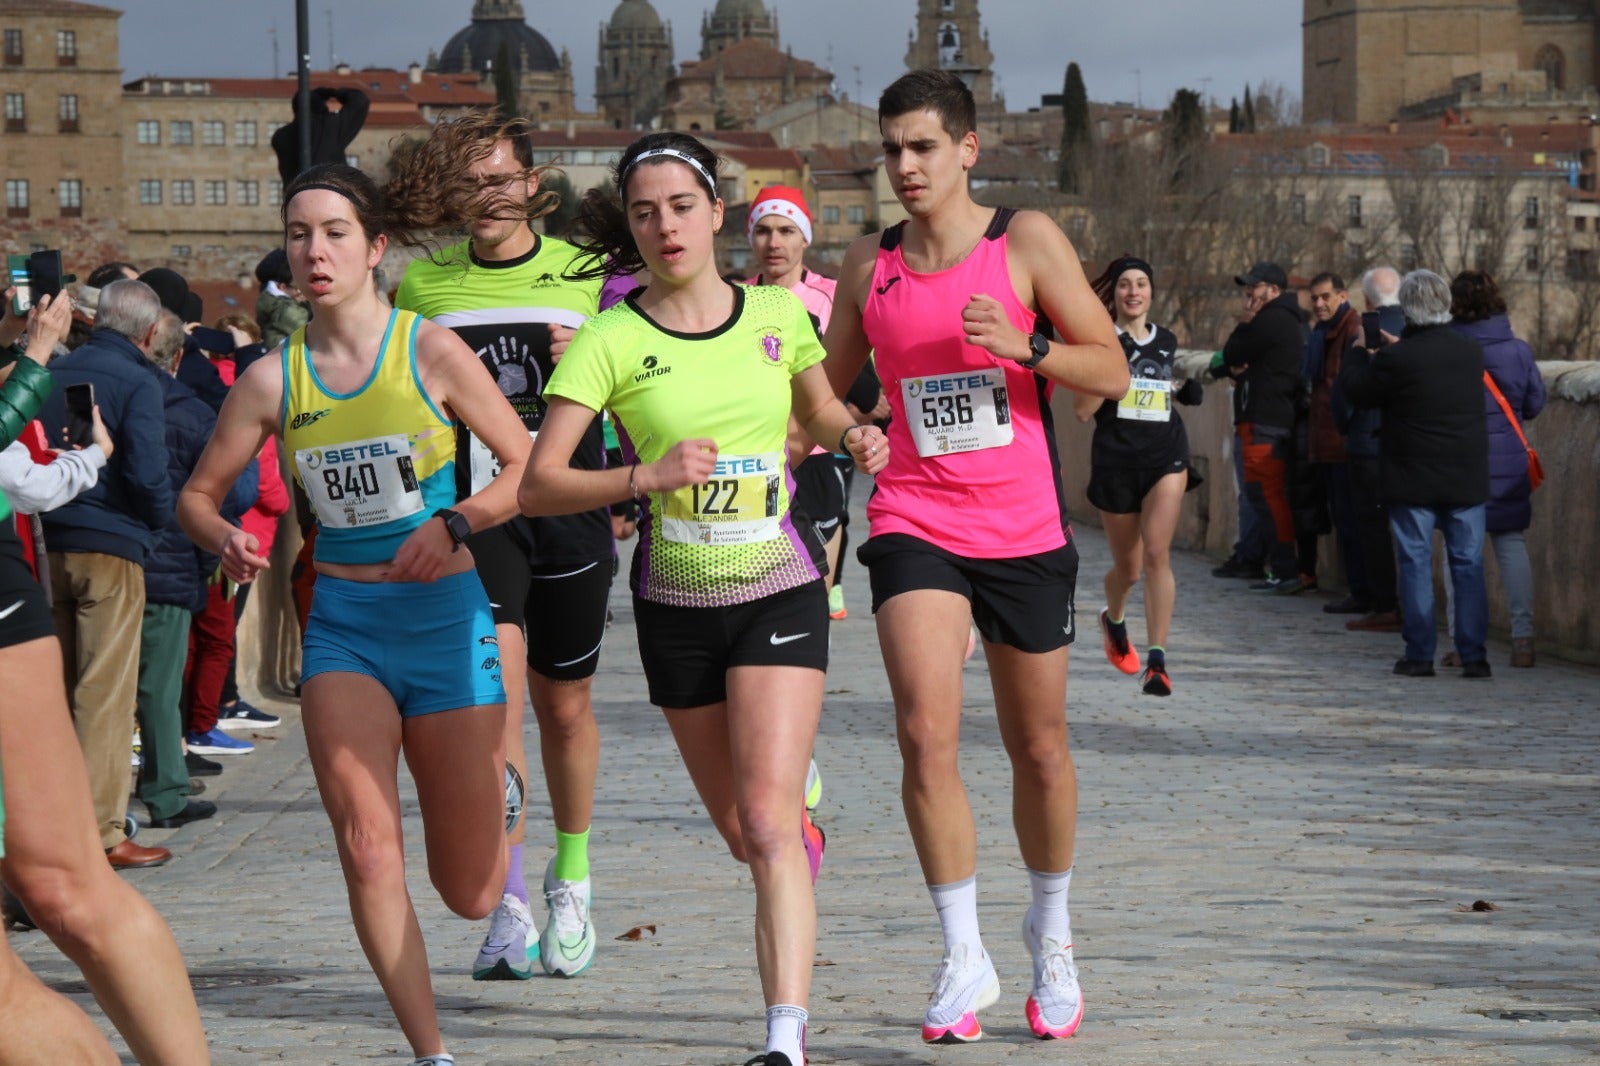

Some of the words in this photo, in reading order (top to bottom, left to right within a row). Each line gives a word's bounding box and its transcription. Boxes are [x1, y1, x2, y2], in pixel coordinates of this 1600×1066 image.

[634, 366, 672, 384] VIATOR
[925, 375, 994, 393] SETEL
[1136, 381, 1166, 390] SETEL
[1135, 390, 1154, 406] 127
[921, 394, 974, 428] 536
[325, 442, 398, 465] SETEL
[714, 458, 768, 475] ETEL
[323, 463, 380, 501] 840
[692, 480, 739, 515] 122
[692, 514, 739, 523] ALEJANDRA
